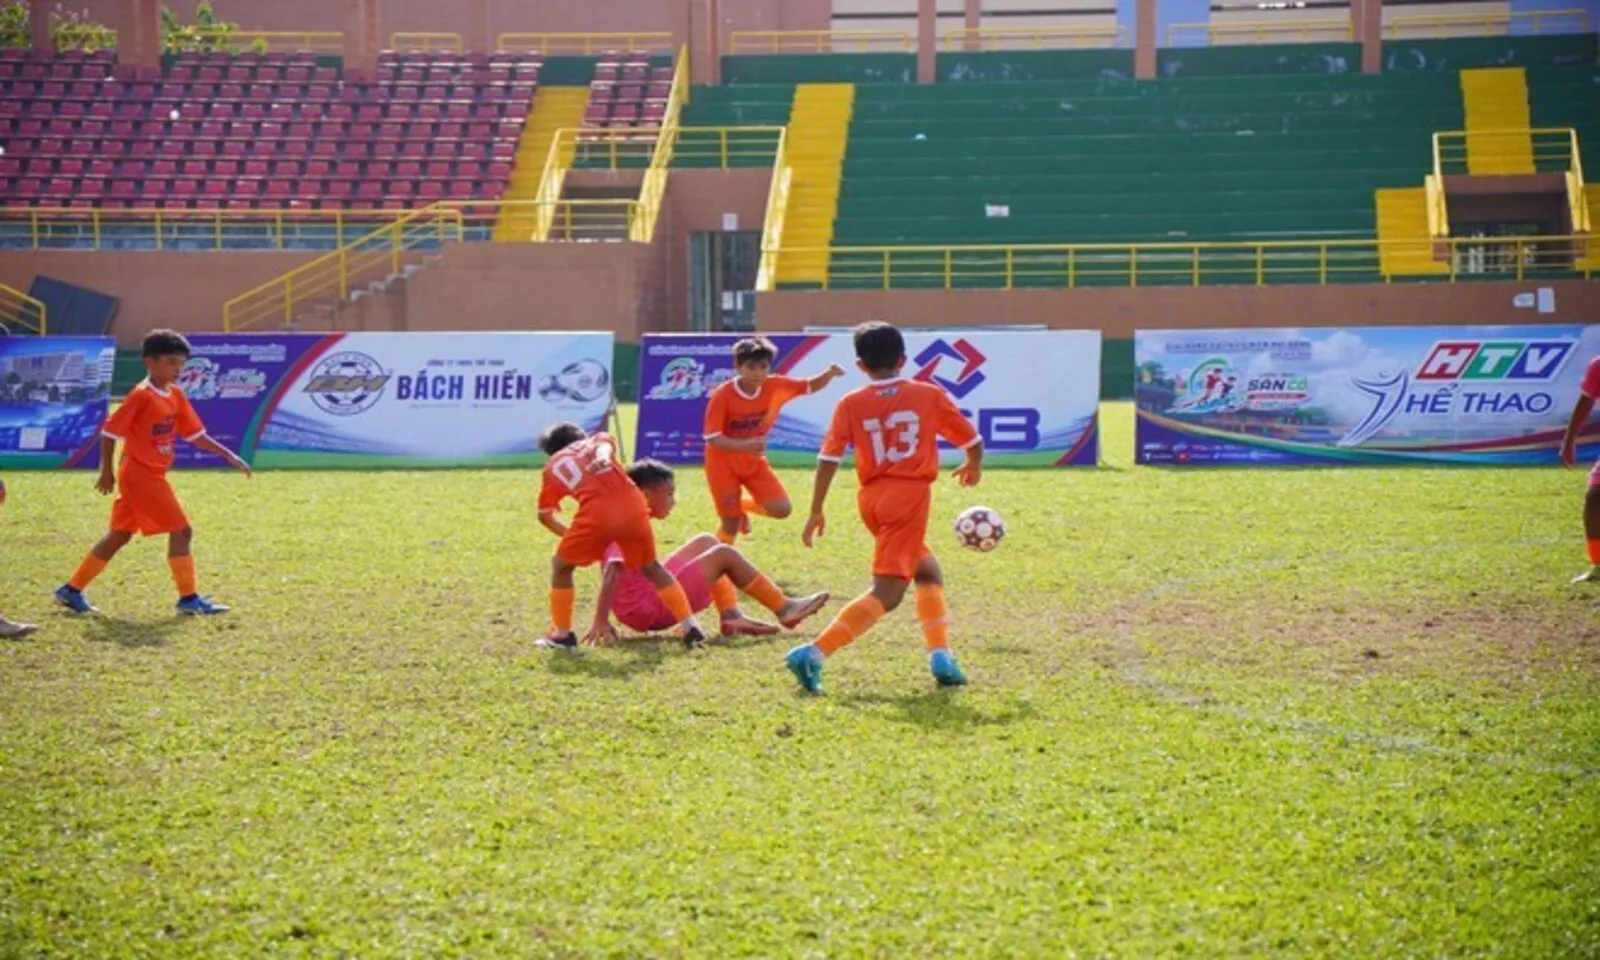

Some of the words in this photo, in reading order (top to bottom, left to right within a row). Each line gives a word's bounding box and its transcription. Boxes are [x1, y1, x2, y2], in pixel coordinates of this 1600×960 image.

[1420, 346, 1566, 376] HTV
[397, 369, 463, 400] BÁCH
[1463, 392, 1553, 413] THAO
[862, 410, 920, 465] 13
